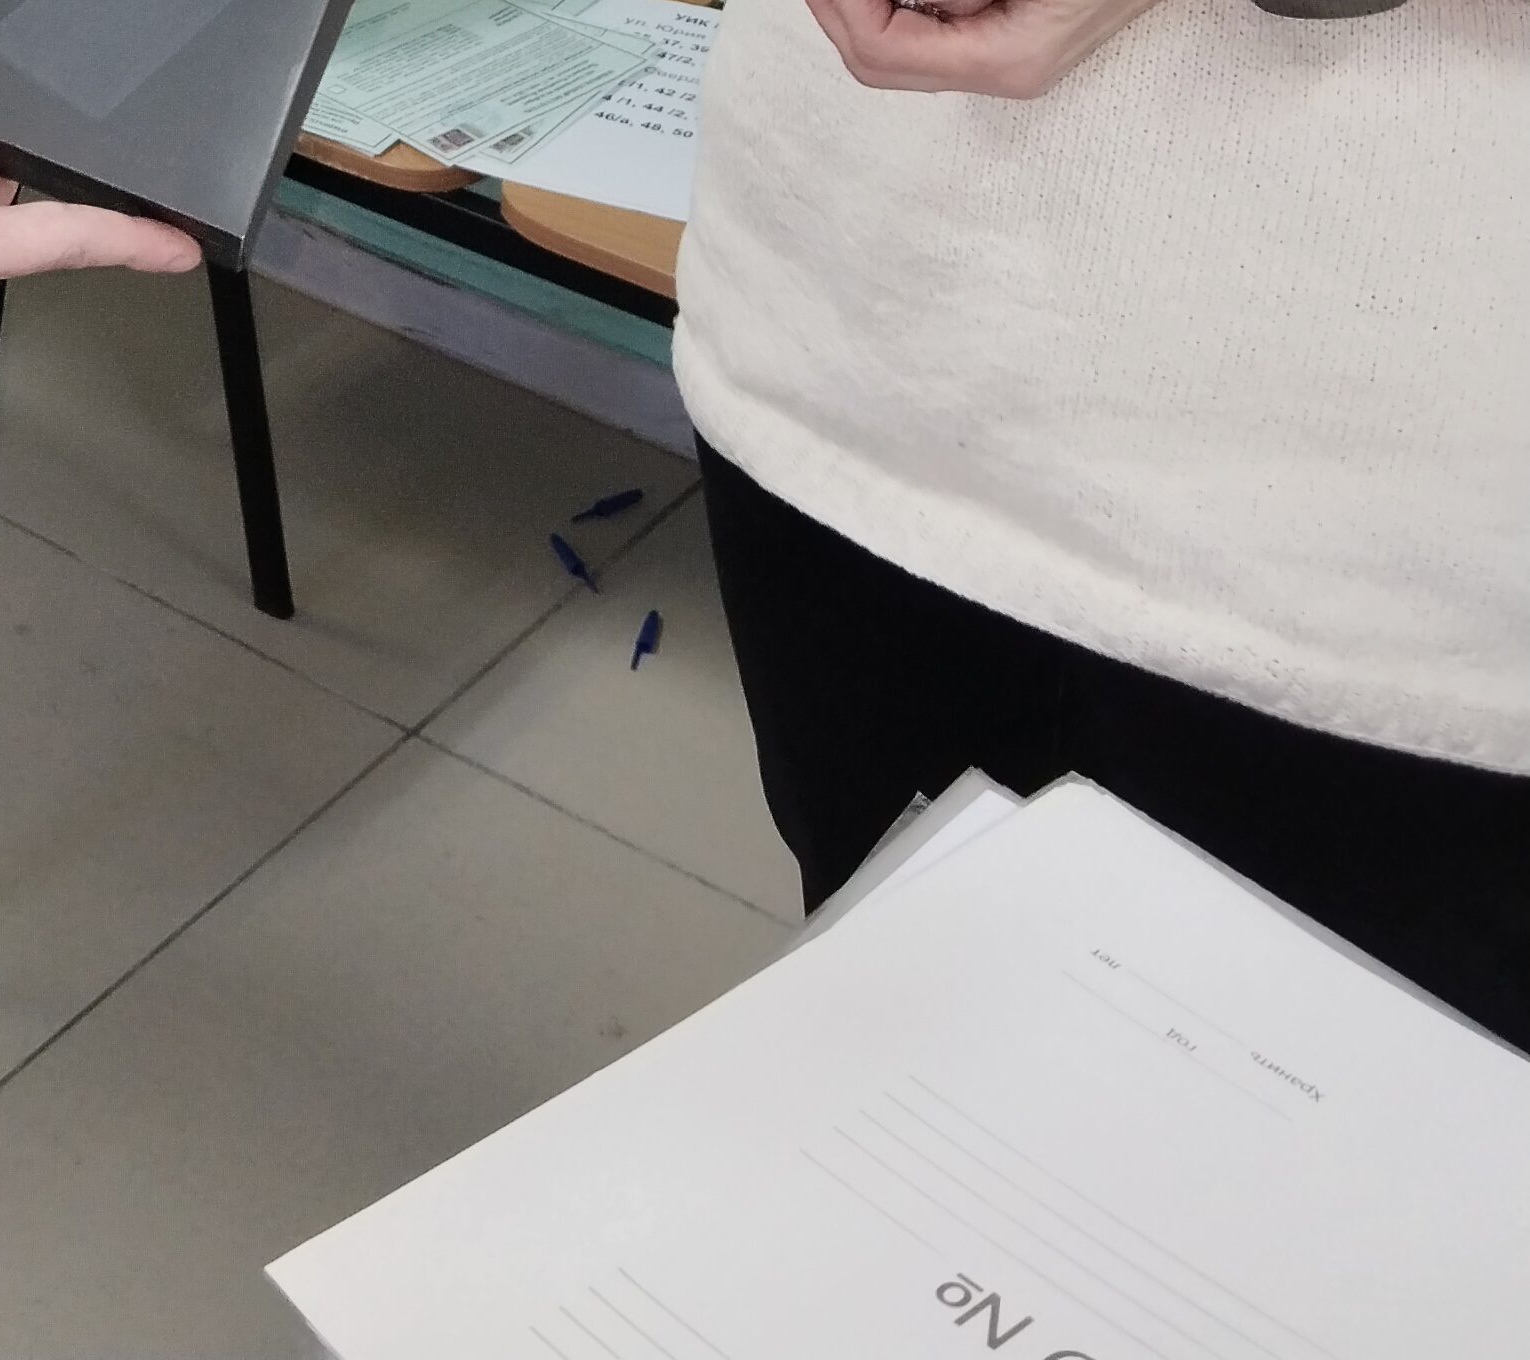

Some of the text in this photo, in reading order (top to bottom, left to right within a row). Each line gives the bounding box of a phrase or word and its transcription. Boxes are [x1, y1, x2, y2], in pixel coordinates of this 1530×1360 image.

[675, 13, 711, 28] УИК
[672, 127, 695, 139] 50
[1090, 947, 1326, 1104] Хранить лет
[934, 1272, 1036, 1351] №
